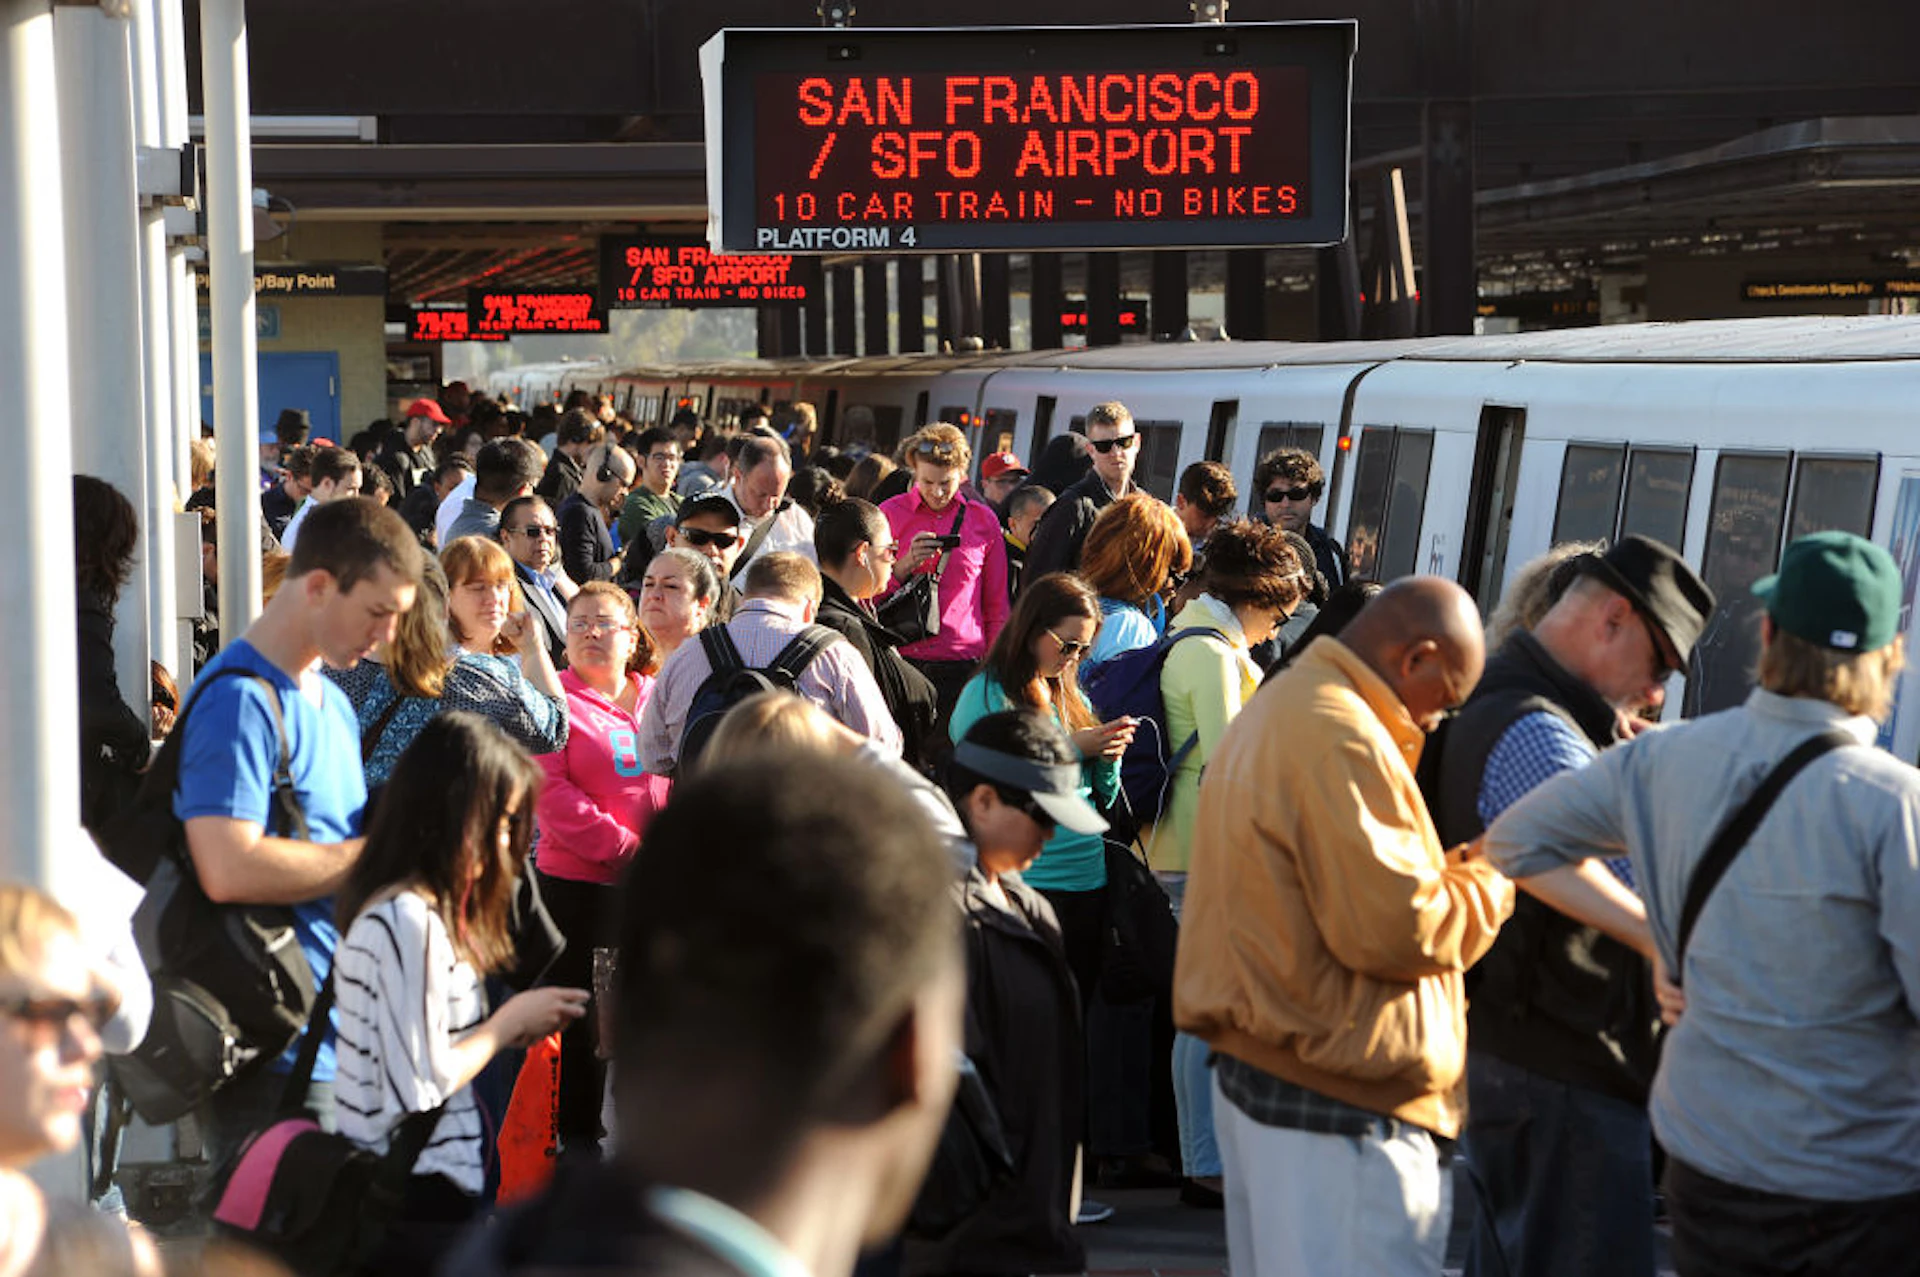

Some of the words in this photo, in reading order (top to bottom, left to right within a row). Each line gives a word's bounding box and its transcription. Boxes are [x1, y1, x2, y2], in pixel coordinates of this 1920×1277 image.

[798, 77, 913, 126] SAN
[945, 71, 1260, 124] FRANCISCO
[808, 133, 837, 180] /
[870, 130, 983, 179] SFO
[1015, 126, 1253, 178] AIRPORT
[774, 192, 817, 221] 10
[837, 191, 914, 220] CAR
[934, 188, 1054, 219] TRAIN
[1074, 198, 1095, 206] -
[1114, 188, 1164, 217] NO
[1183, 185, 1298, 215] BIKES
[756, 227, 890, 249] PLATFORM
[899, 226, 917, 247] 4
[625, 247, 670, 266] SAN
[297, 273, 336, 289] Point
[630, 267, 643, 286] /
[651, 266, 695, 286] SFO
[704, 265, 790, 285] AIRPORT
[617, 288, 636, 301] 10
[640, 287, 671, 300] CAR
[675, 286, 721, 300] TRAIN
[738, 287, 759, 300] NO
